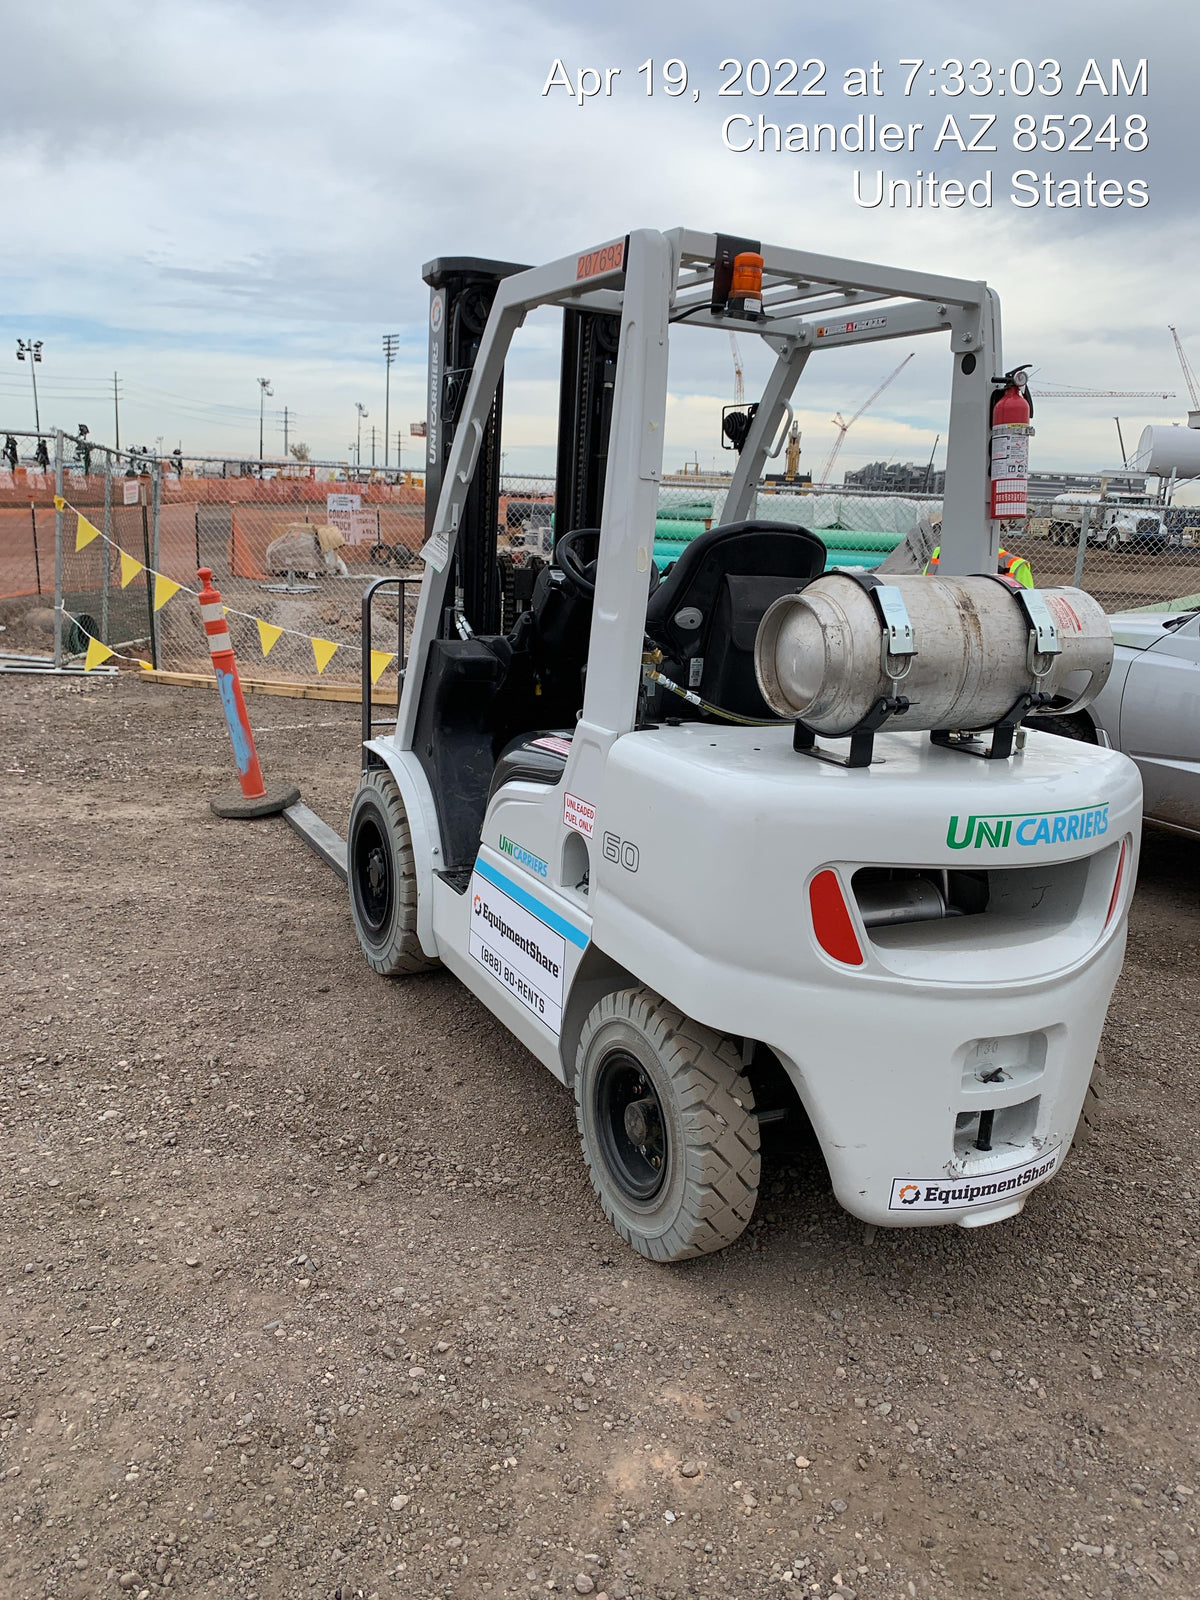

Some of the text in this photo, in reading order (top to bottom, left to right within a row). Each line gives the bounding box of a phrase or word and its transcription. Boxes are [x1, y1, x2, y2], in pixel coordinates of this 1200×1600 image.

[577, 242, 623, 279] 207693
[565, 811, 593, 833] FUEL ONLY
[566, 797, 595, 820] UNLEADED
[602, 830, 640, 873] 60
[482, 901, 560, 979] EquipmentShare
[481, 944, 545, 1015] (888) 80-RENTS
[923, 1157, 1056, 1204] EquipmentShare
